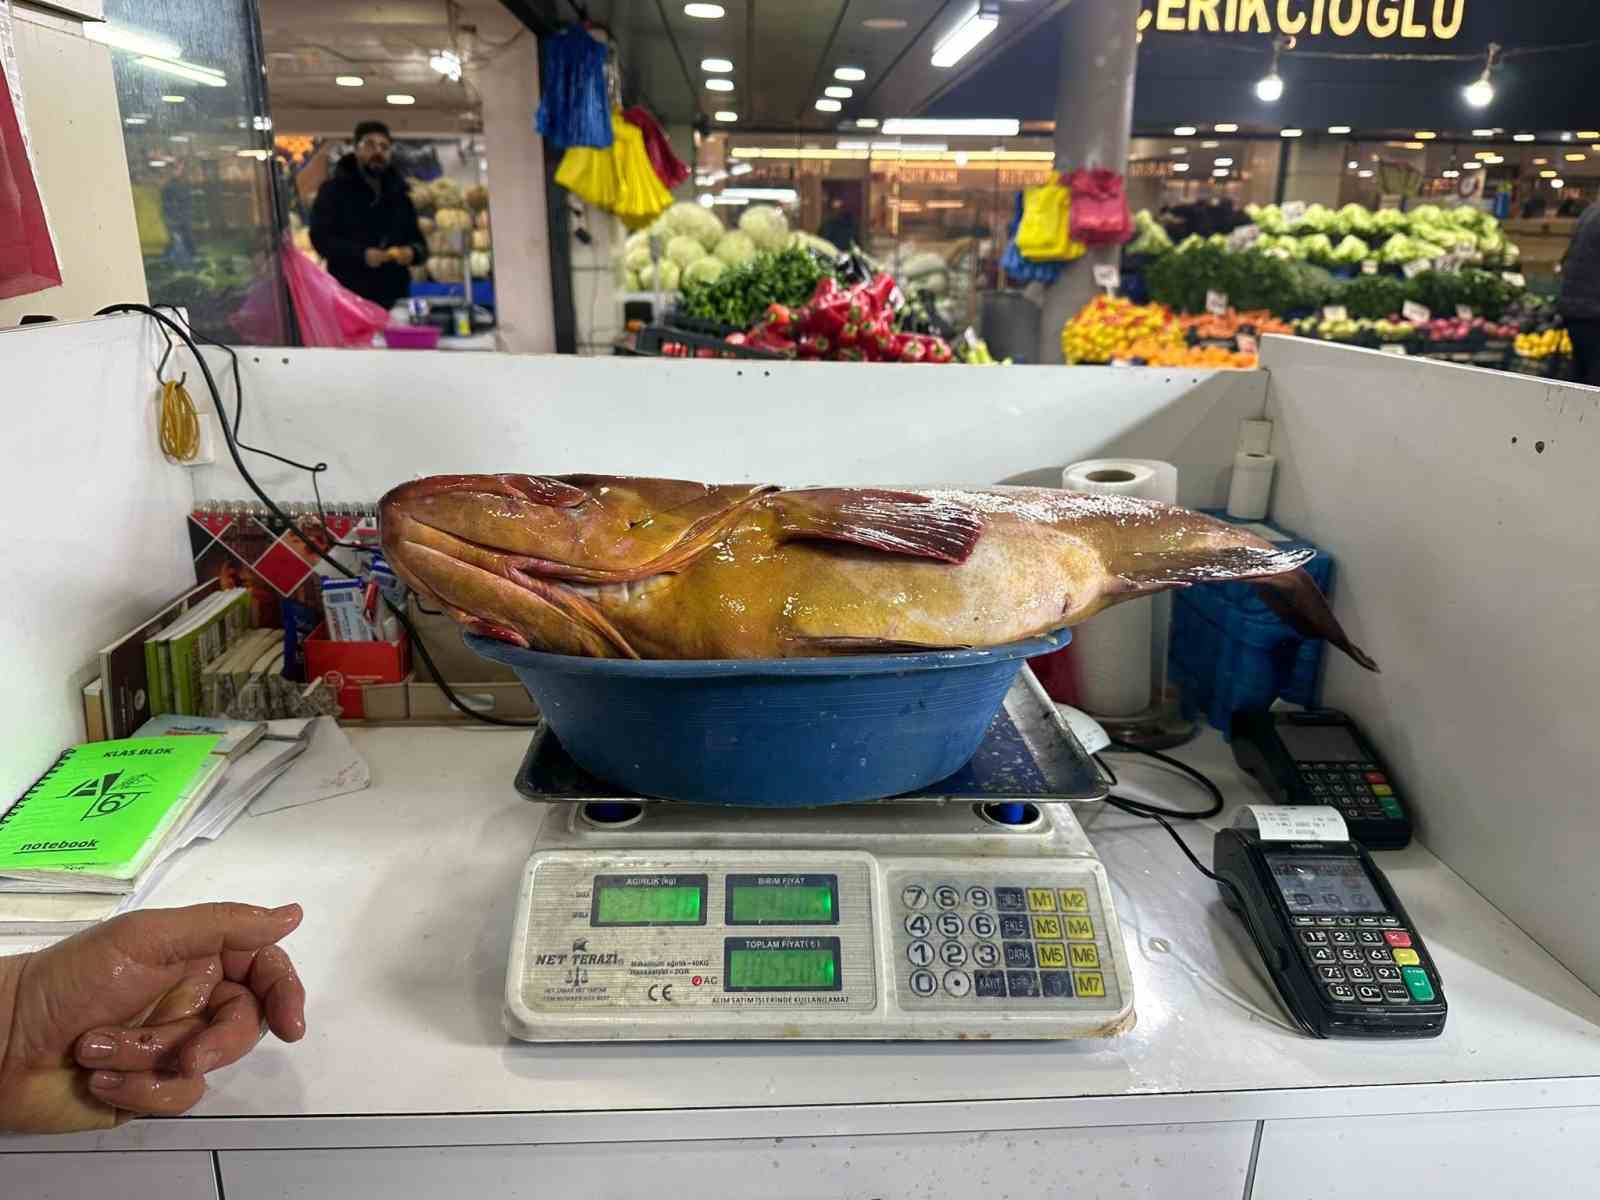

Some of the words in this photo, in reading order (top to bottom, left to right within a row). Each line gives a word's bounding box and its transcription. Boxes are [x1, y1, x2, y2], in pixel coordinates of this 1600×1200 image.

[20, 839, 98, 851] notebook
[906, 888, 922, 907] 7
[939, 889, 956, 907] 8
[971, 889, 988, 907] 9
[1032, 892, 1053, 906] M1
[1063, 893, 1085, 907] M2
[909, 915, 927, 935] 4
[942, 915, 960, 935] 5
[975, 916, 992, 935] 6
[1036, 918, 1058, 934] M3
[1068, 919, 1090, 934] M4
[535, 953, 567, 966] NET
[571, 950, 619, 966] TERAZİ
[914, 943, 927, 964] 1
[945, 943, 963, 963] 2
[979, 944, 996, 964] 3
[1040, 946, 1064, 962] M5
[1072, 947, 1096, 962] M6
[914, 973, 933, 993] 0
[1078, 976, 1100, 993] M7
[647, 983, 673, 1002] CE
